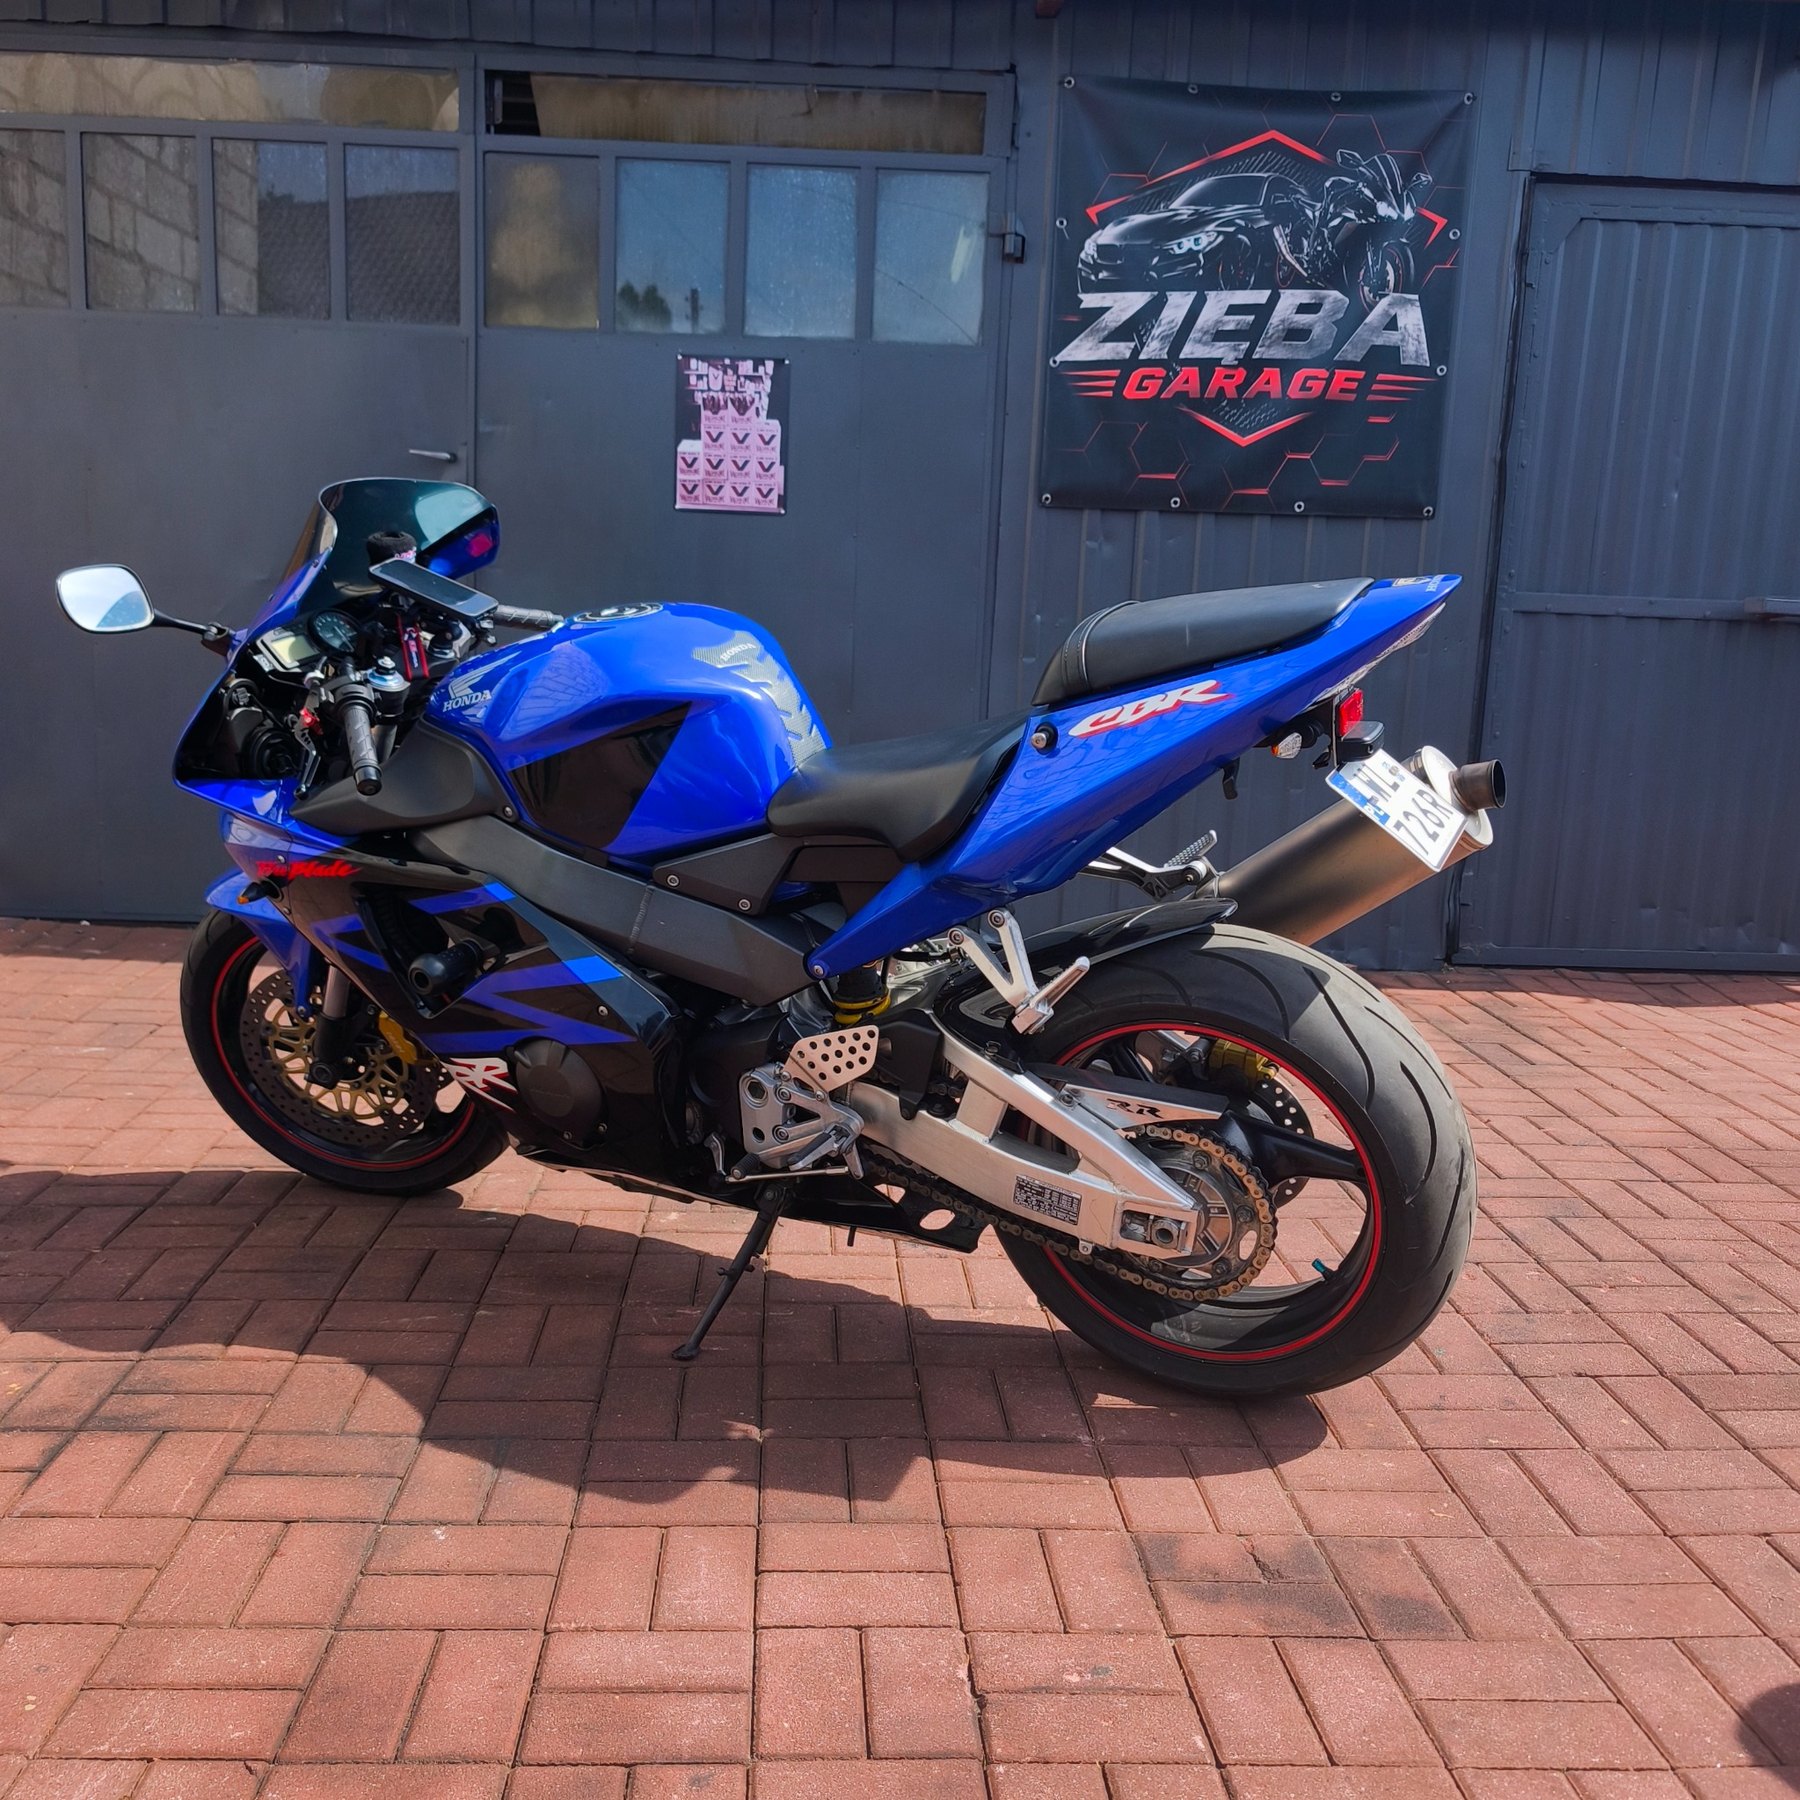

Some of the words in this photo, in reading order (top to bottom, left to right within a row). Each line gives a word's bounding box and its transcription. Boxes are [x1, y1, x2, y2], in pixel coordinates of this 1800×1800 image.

[1056, 290, 1431, 366] ZIĘBA
[1122, 366, 1366, 401] GARAGE
[720, 643, 756, 661] HONDA
[443, 690, 492, 712] HONDA
[1068, 679, 1236, 739] CBR
[1393, 789, 1453, 856] 726R
